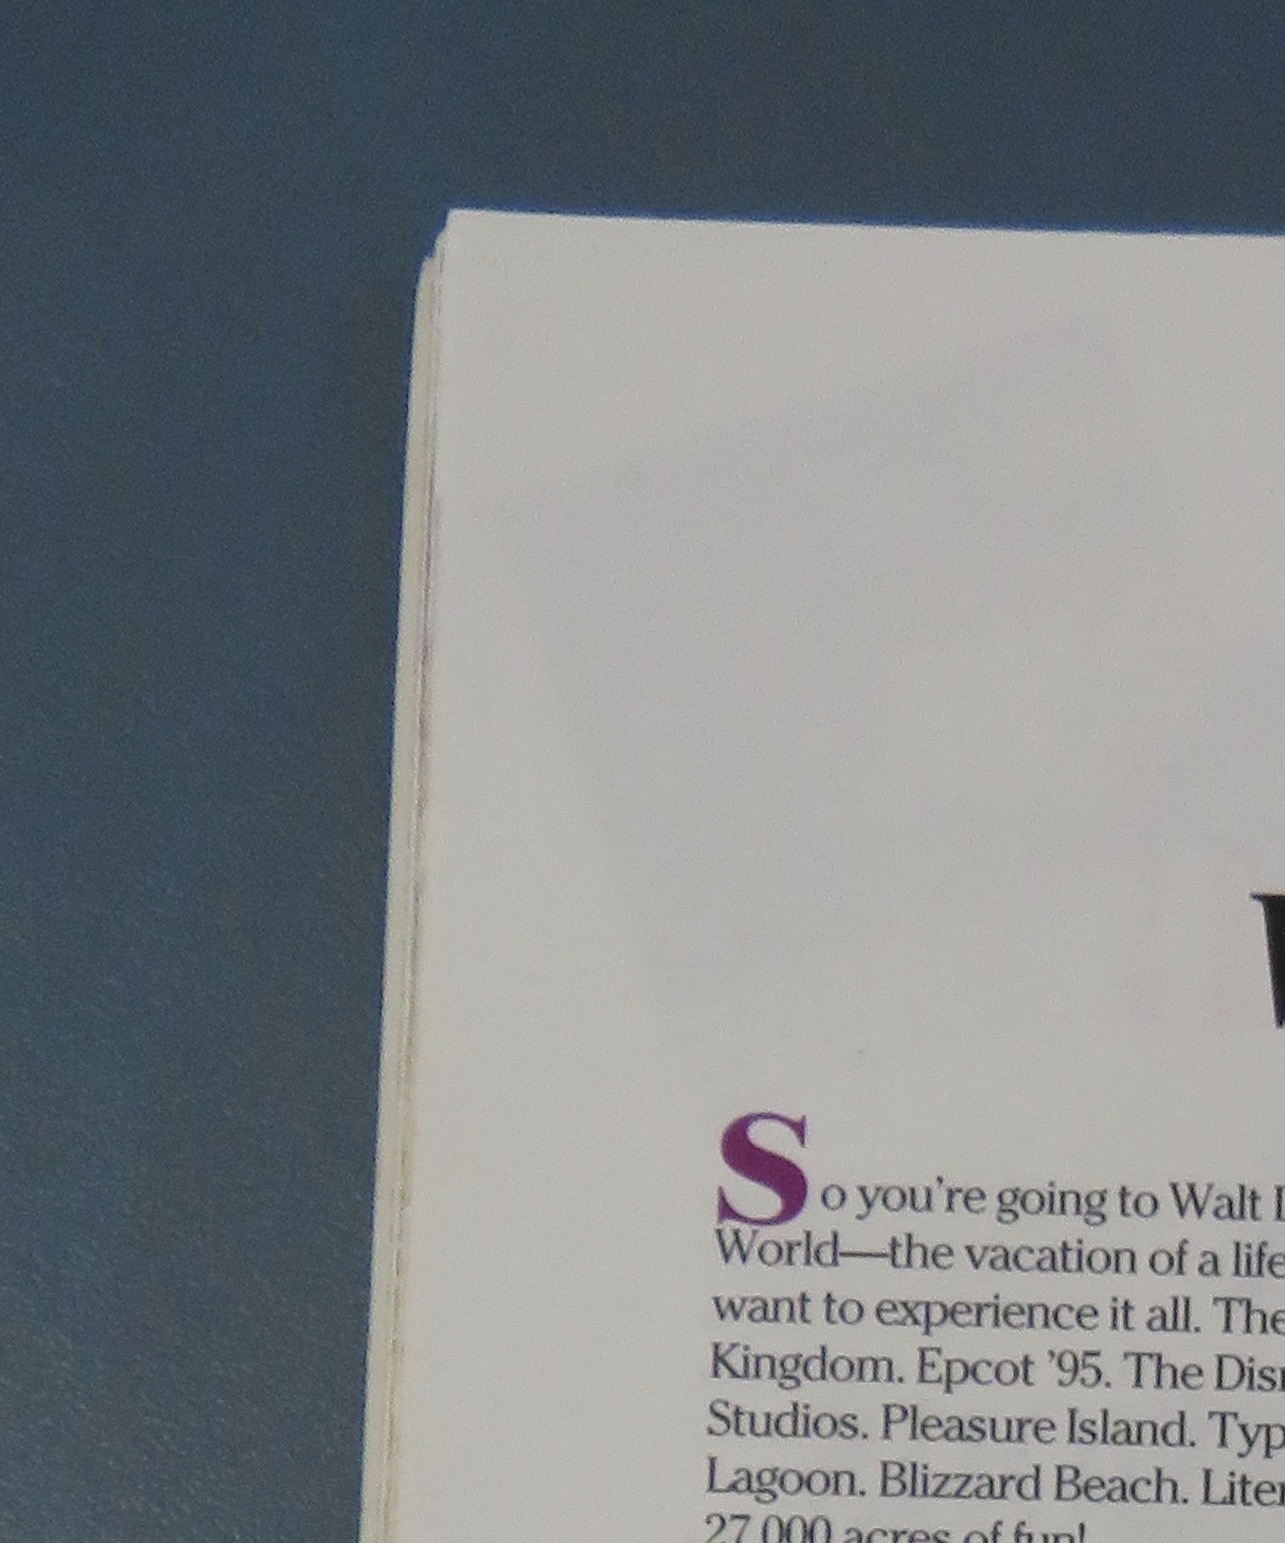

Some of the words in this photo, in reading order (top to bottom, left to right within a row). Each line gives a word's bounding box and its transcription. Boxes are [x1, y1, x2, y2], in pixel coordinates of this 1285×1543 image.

[712, 1292, 811, 1324] want
[823, 1292, 865, 1325] to
[875, 1293, 1099, 1336] experience
[1110, 1296, 1135, 1331] it
[1146, 1296, 1201, 1333] all.
[707, 1399, 868, 1440] Studios.
[882, 1403, 1057, 1445] Pleasure
[1067, 1408, 1196, 1447] Island.
